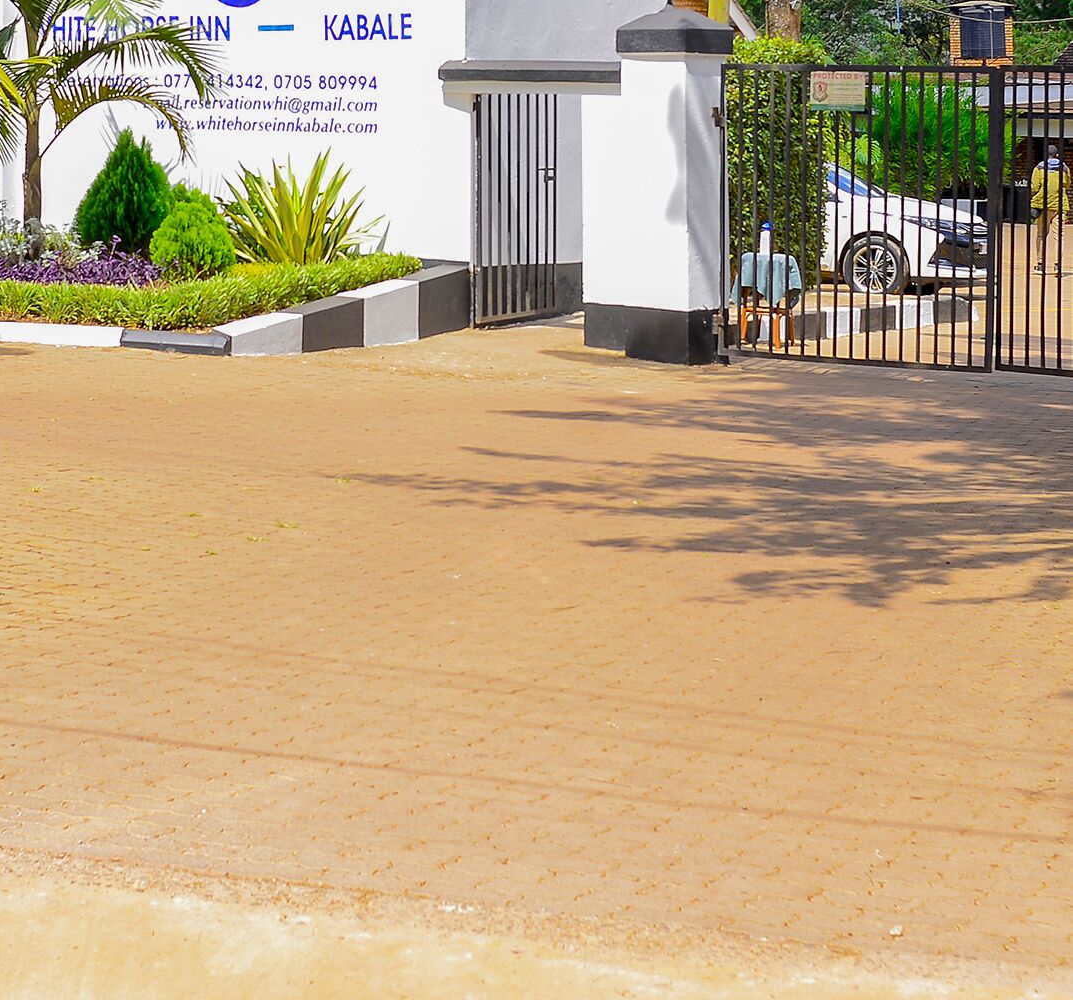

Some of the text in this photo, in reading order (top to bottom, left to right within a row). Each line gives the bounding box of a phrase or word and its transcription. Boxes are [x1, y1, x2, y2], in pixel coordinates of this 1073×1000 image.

[190, 15, 230, 41] INN
[324, 13, 412, 40] KABALE
[58, 74, 150, 89] eervations
[164, 74, 201, 88] 077
[273, 75, 312, 89] 0705
[318, 75, 377, 90] 809994
